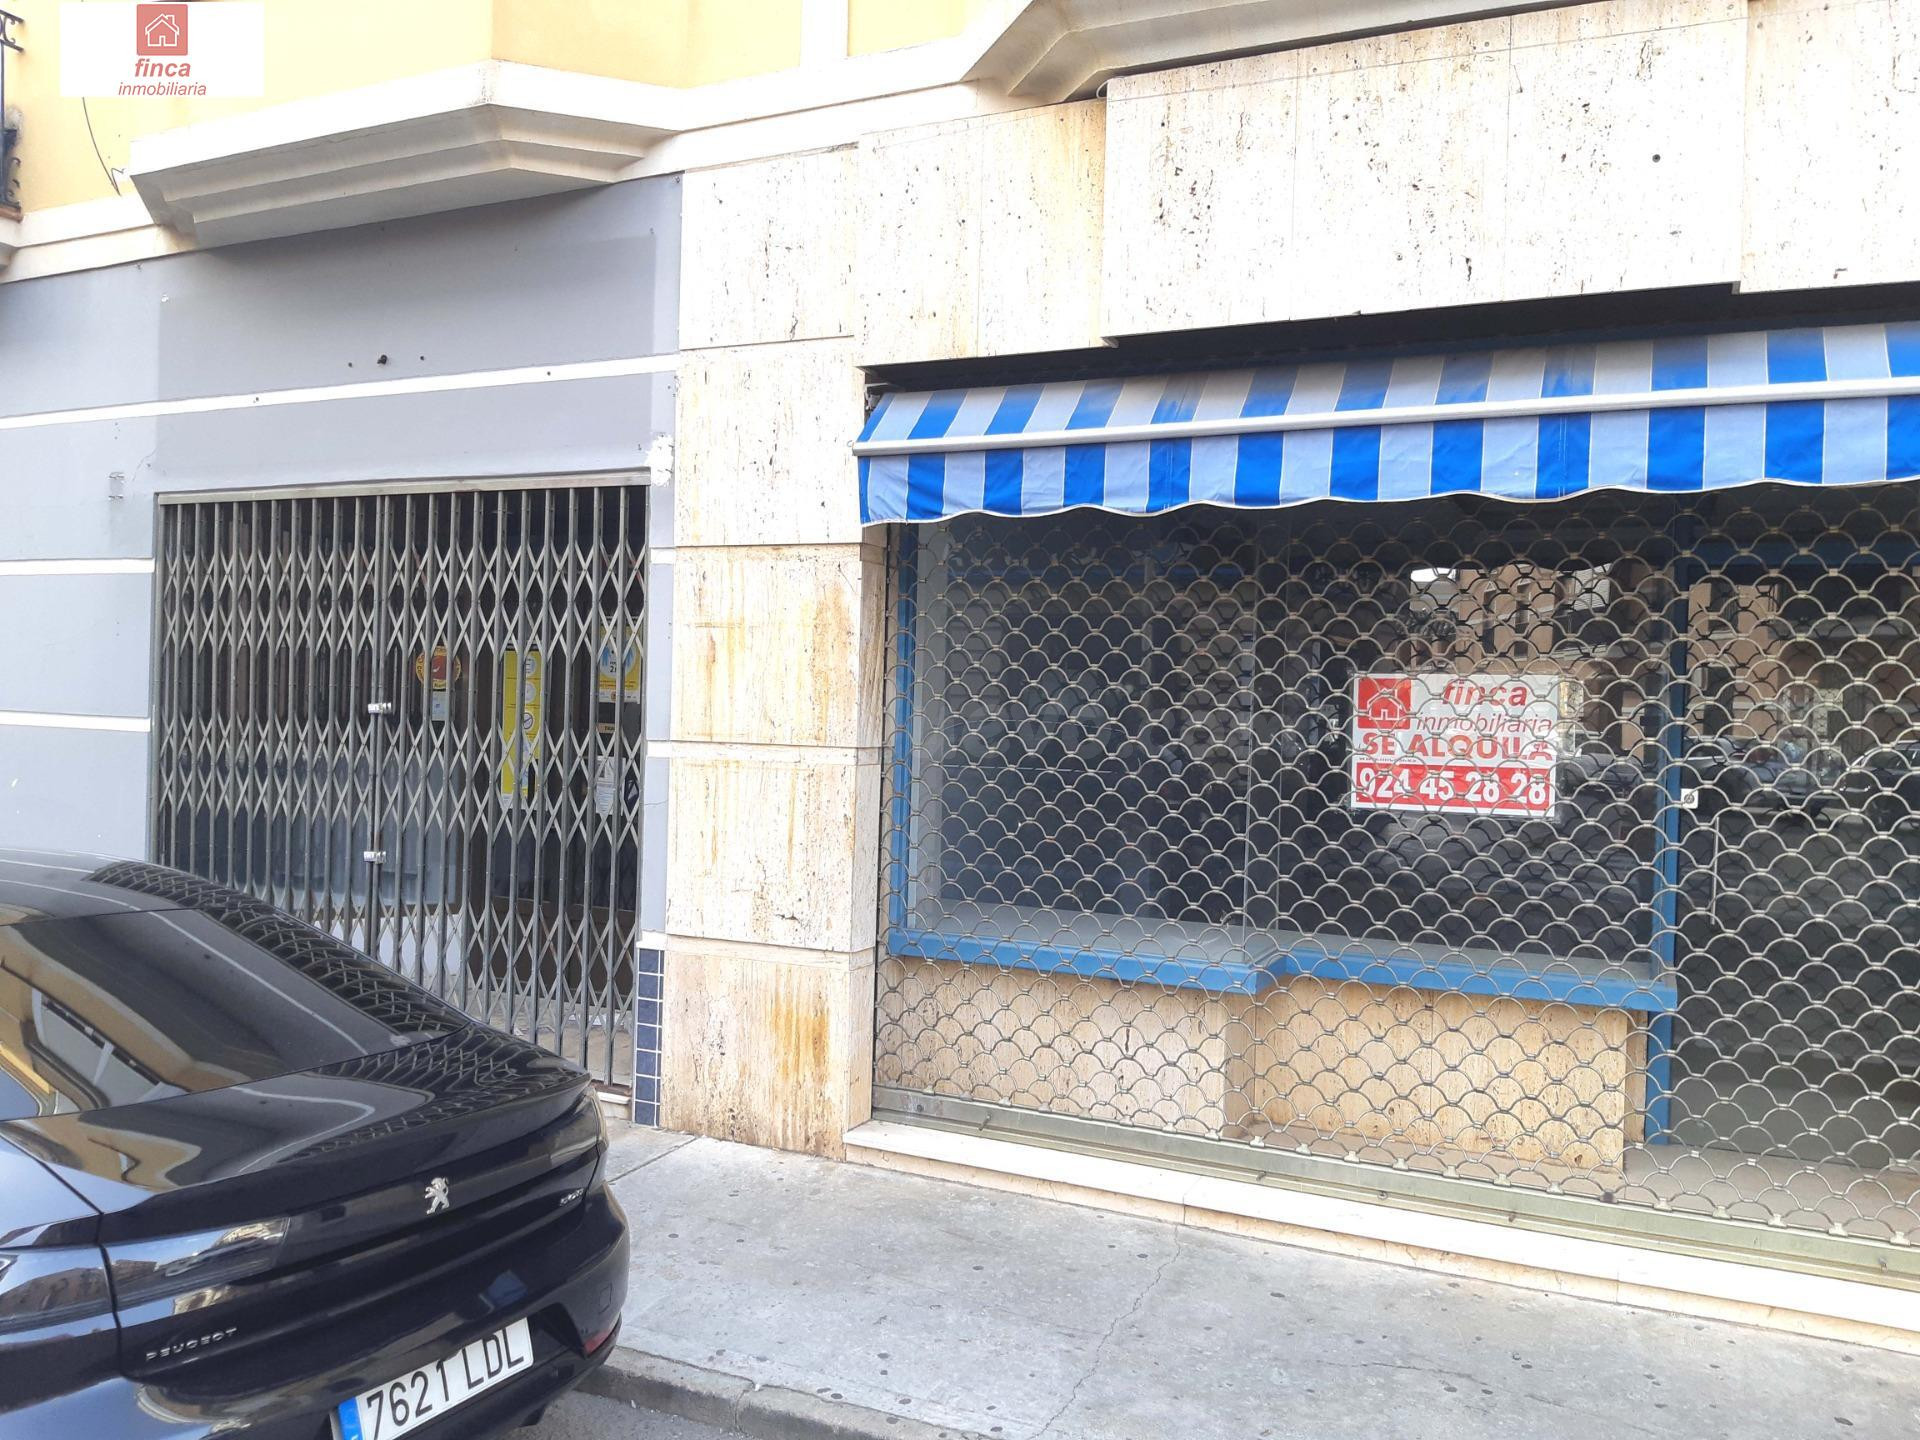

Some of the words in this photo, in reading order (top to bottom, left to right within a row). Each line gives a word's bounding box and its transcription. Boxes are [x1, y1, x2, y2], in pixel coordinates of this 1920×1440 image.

[1441, 680, 1527, 706] finca
[1416, 711, 1552, 734] inmobiliaria
[1362, 732, 1396, 755] SE
[1360, 767, 1412, 799] 924
[1420, 770, 1455, 801] 45
[1465, 771, 1500, 803] 28
[1511, 772, 1547, 805] 28
[145, 1327, 238, 1361] PEUGEOT
[366, 1360, 450, 1440] 7621
[462, 1327, 525, 1390] LDL
